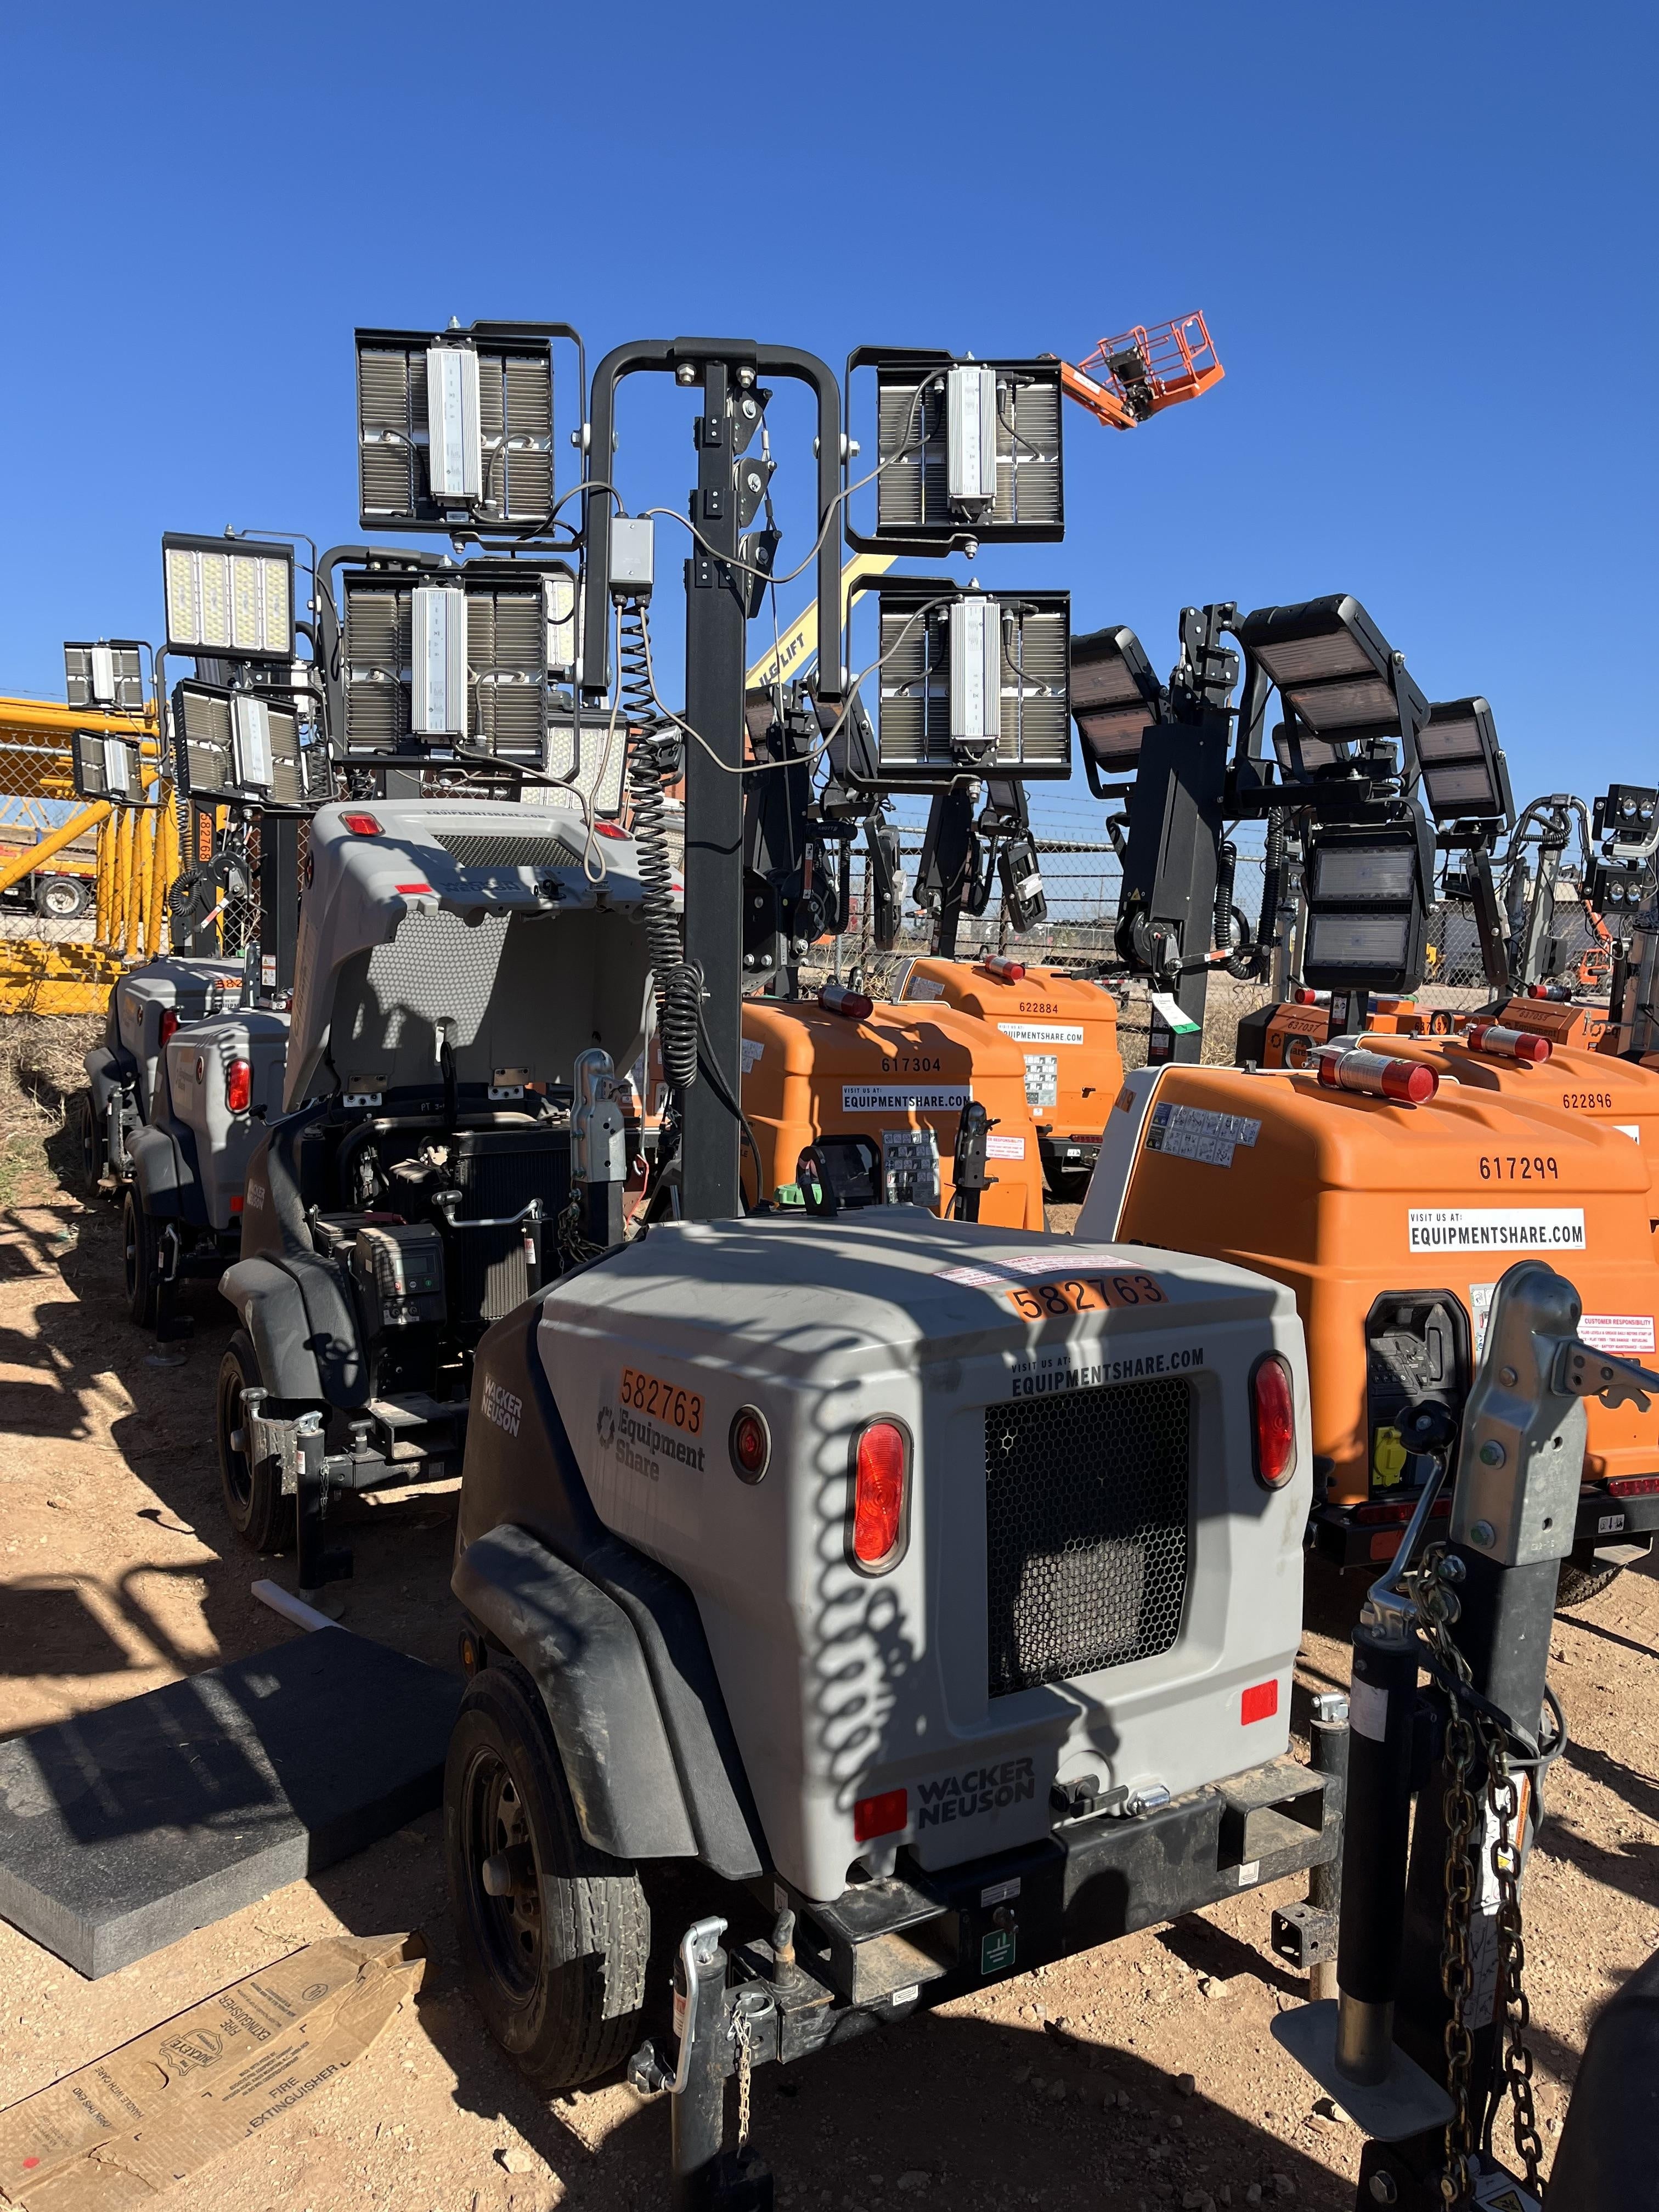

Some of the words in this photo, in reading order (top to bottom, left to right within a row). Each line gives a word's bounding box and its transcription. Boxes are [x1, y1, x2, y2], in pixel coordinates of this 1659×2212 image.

[780, 632, 804, 668] LIFT
[426, 810, 546, 819] EQUIPMENTSHARE.COM
[200, 814, 211, 860] 582768
[1019, 1002, 1058, 1014] 622884
[1002, 1030, 1082, 1042] QUIPMENTSHARE.COM
[1288, 1021, 1319, 1032] 637037
[882, 1057, 941, 1072] 617304
[844, 1096, 970, 1108] EQUIPMENTSHARE.COM
[1563, 1093, 1612, 1108] 622896
[1480, 1157, 1558, 1180] 617299
[1410, 1214, 1432, 1222] VISIT
[1436, 1214, 1446, 1222] US
[1450, 1214, 1462, 1222] AT:
[1412, 1226, 1583, 1246] EQUIPMENTSHARE.COM
[1013, 1276, 1163, 1319] 582763
[1011, 1362, 1037, 1373] VISIT
[1042, 1359, 1053, 1368] US
[1057, 1357, 1071, 1367] AT:
[1012, 1348, 1204, 1397] EQUIPMENTSHARE.COM
[484, 1375, 522, 1419] WACKER
[622, 1369, 701, 1433] 582763
[481, 1395, 520, 1437] NEUSON
[618, 1407, 705, 1472] Equipment
[615, 1438, 659, 1481] Share
[917, 1757, 1035, 1805] WACKER
[918, 1778, 1035, 1830] NEUSON
[218, 1994, 272, 2041] EXTINGUISHER
[220, 2018, 242, 2036] FIRE
[170, 2039, 213, 2064] BUCKEYE
[94, 2066, 112, 2083] CARE
[72, 2087, 88, 2101] END
[107, 2082, 125, 2100] WITH
[249, 2064, 338, 2128] EXTINGUISHER
[269, 2076, 300, 2098] FIRE
[82, 2100, 98, 2114] THIS
[120, 2096, 145, 2119] HANDLE
[93, 2112, 112, 2127] OPEN
